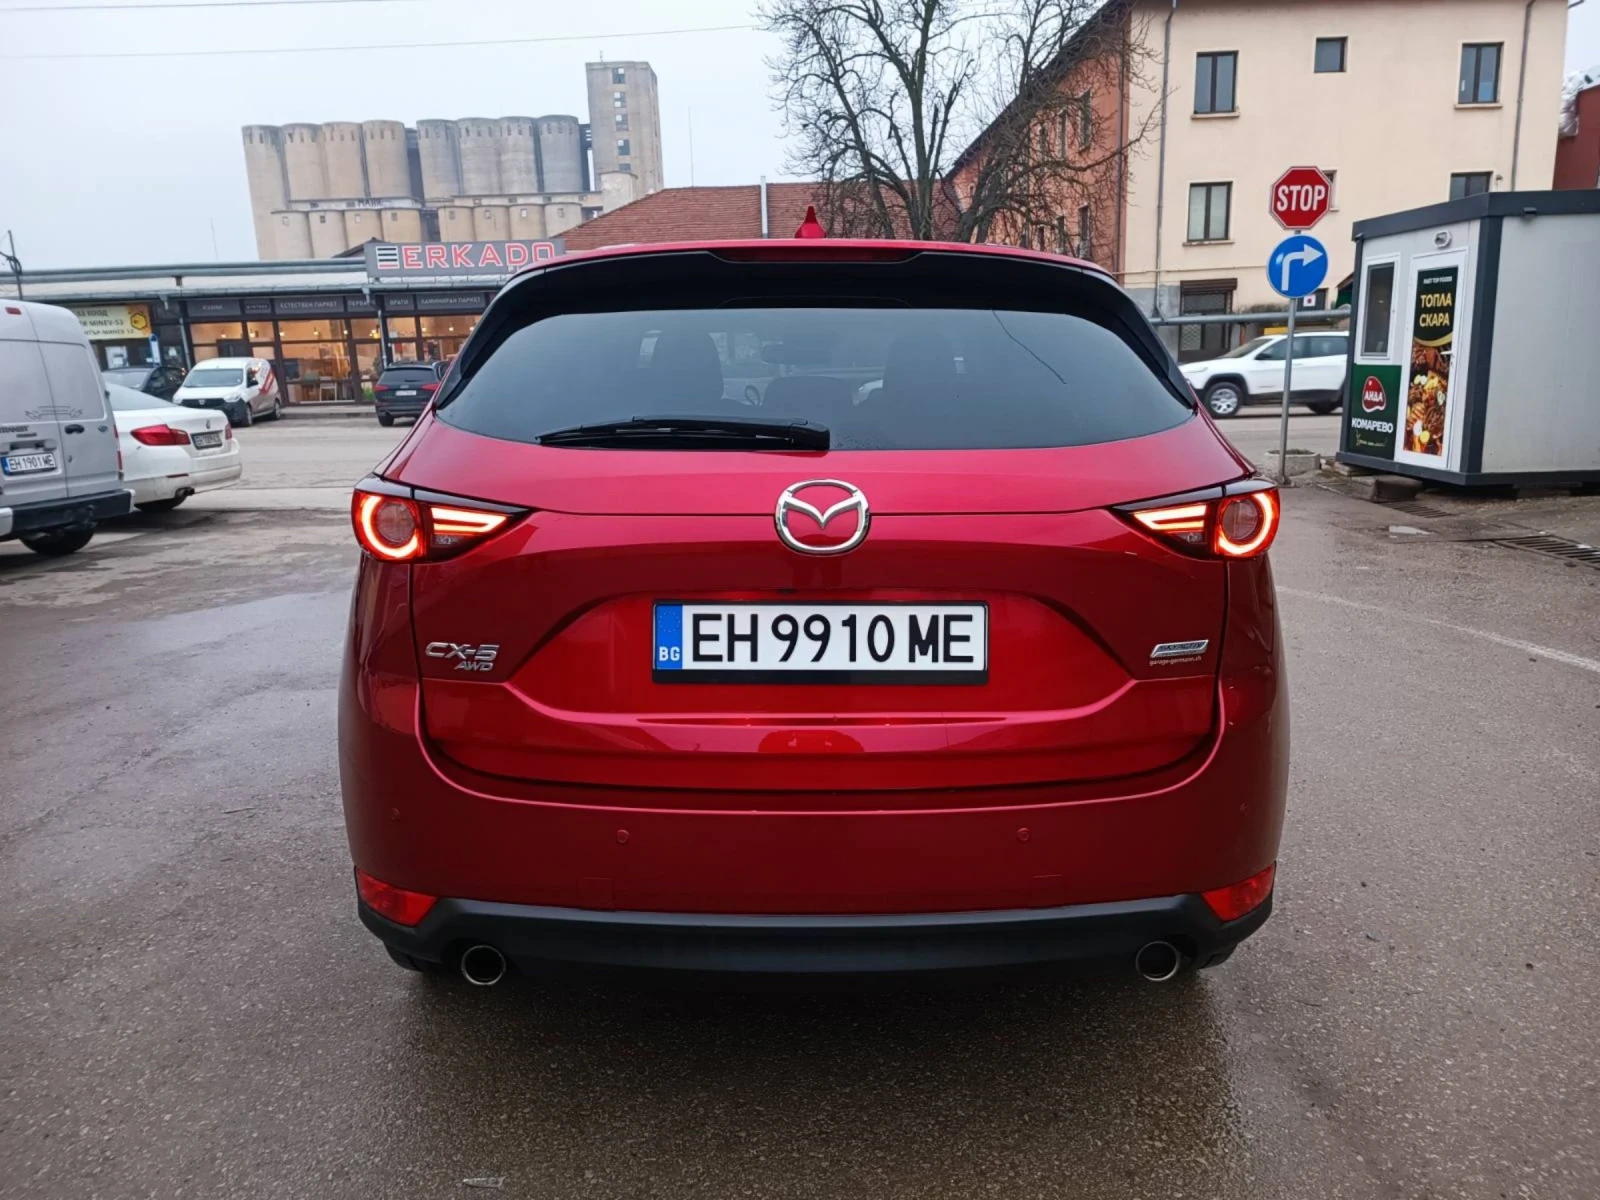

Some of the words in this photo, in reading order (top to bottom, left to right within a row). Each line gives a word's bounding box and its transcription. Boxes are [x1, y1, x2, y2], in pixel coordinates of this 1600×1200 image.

[1276, 184, 1326, 211] STOP
[401, 241, 555, 269] ERKADO
[458, 296, 481, 304] ПАРКЕТ
[1420, 292, 1453, 308] ТОПЛА
[1419, 312, 1450, 327] СКАРА
[1351, 417, 1394, 433] КОМАРЕВО
[692, 613, 758, 662] EH
[771, 613, 895, 663] 9910
[908, 613, 974, 663] ME
[425, 641, 500, 661] CX-5
[658, 646, 681, 662] BG
[453, 660, 494, 672] AWD
